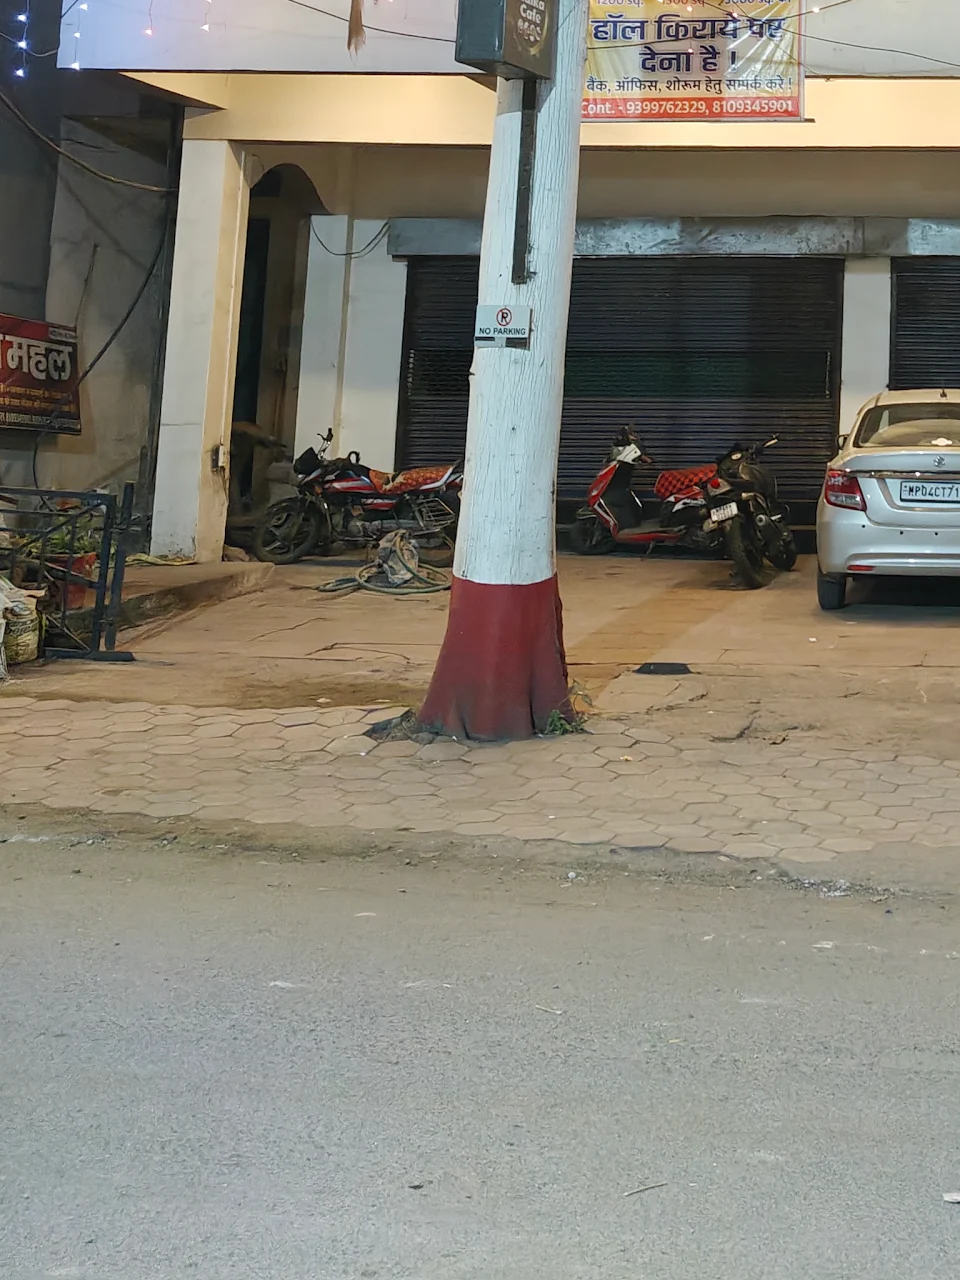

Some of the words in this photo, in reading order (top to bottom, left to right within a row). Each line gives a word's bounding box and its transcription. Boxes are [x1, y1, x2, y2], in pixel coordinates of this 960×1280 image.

[520, 4, 541, 23] Cafe
[591, 14, 648, 40] हॉल
[654, 13, 740, 40] किराये
[639, 46, 694, 72] देना
[699, 45, 720, 72] है
[587, 76, 611, 94] बैंक,
[615, 77, 662, 93] ऑफिस,
[665, 76, 700, 91] शोरूम
[705, 76, 722, 94] हेतु
[581, 102, 615, 114] Cont.
[626, 101, 709, 115] 9399762329,
[712, 100, 793, 113] 8109345901
[479, 327, 491, 335] NO
[493, 327, 526, 335] PARKING
[5, 335, 73, 381] महल
